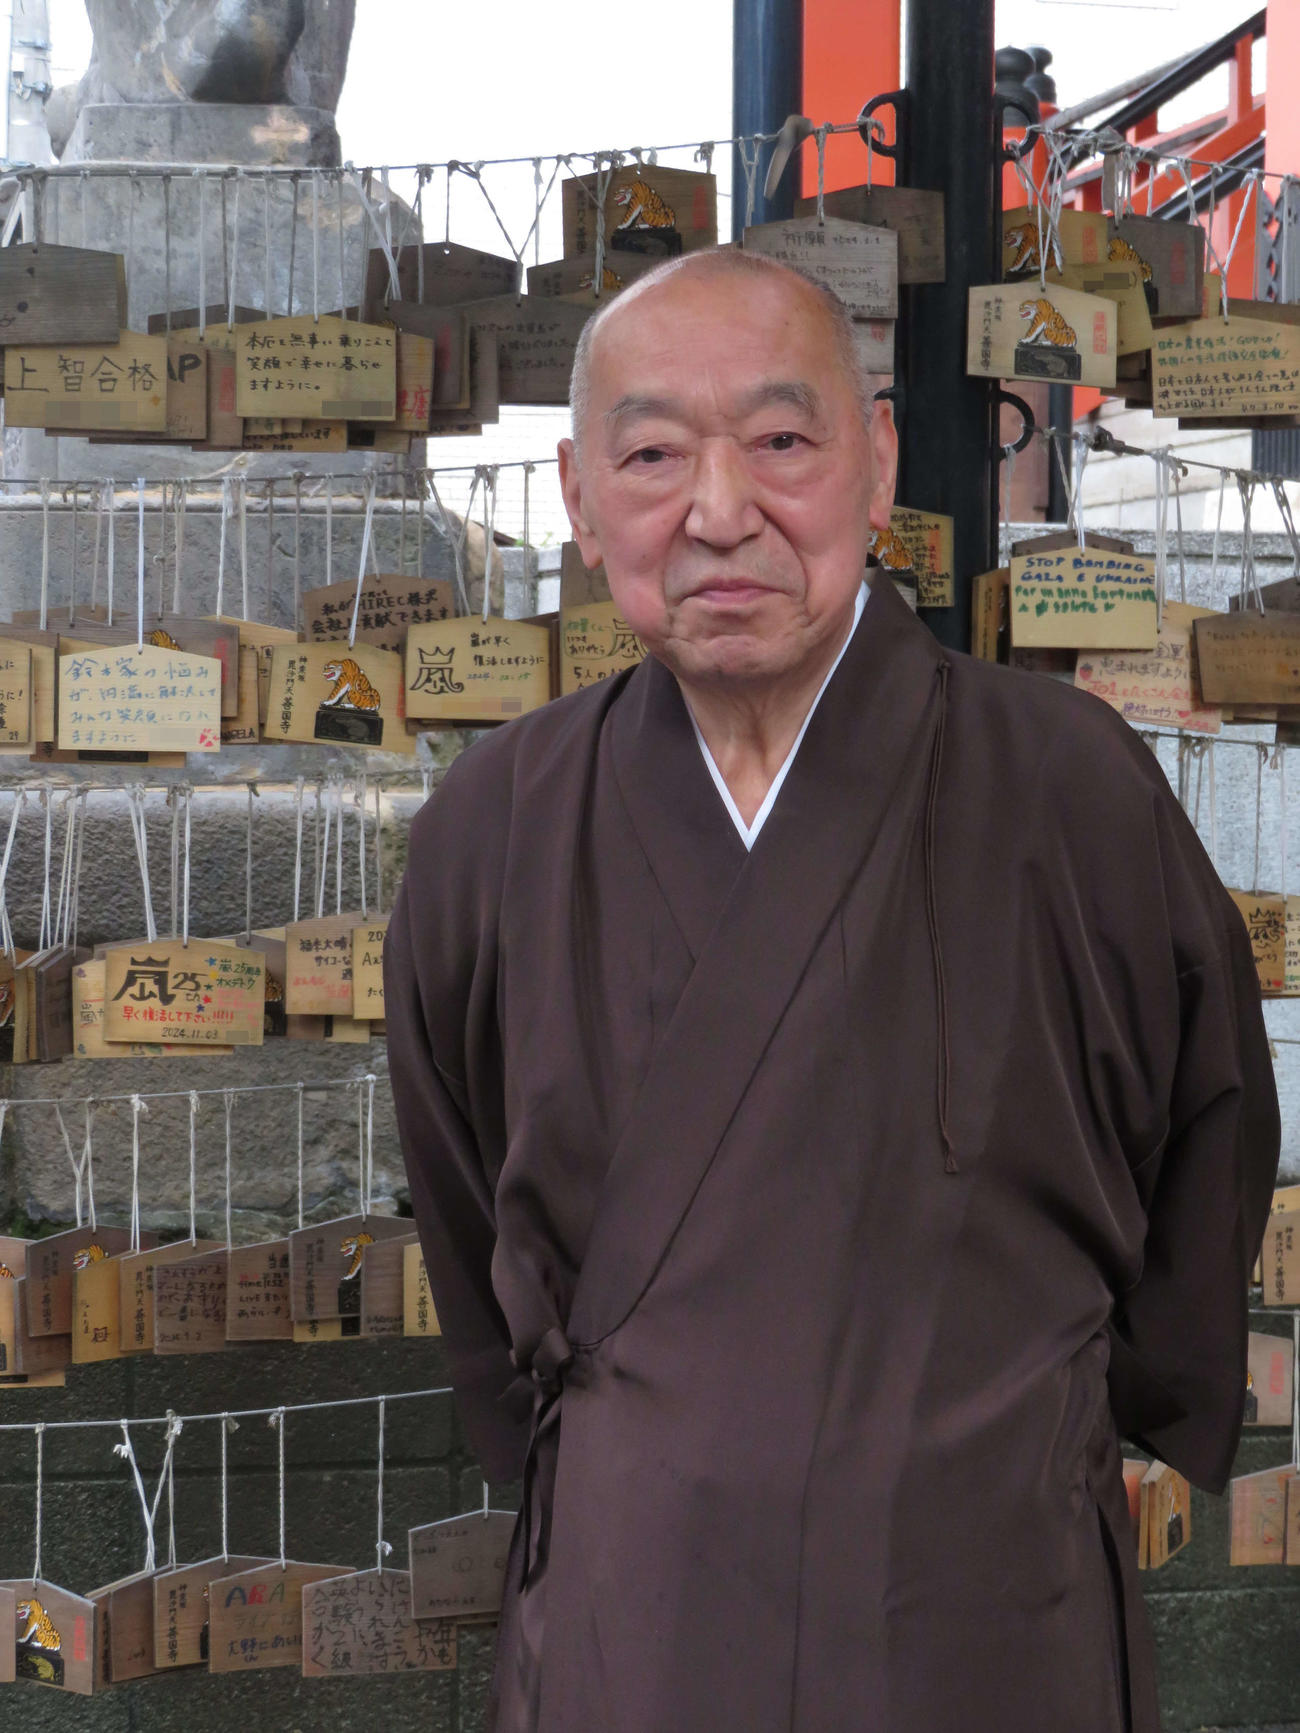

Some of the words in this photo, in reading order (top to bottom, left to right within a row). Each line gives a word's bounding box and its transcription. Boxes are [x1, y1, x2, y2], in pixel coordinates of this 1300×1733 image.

[7, 354, 158, 393] 上智合格
[250, 377, 321, 391] ますように。
[1026, 556, 1065, 568] STOP
[1021, 571, 1064, 582] GAZA
